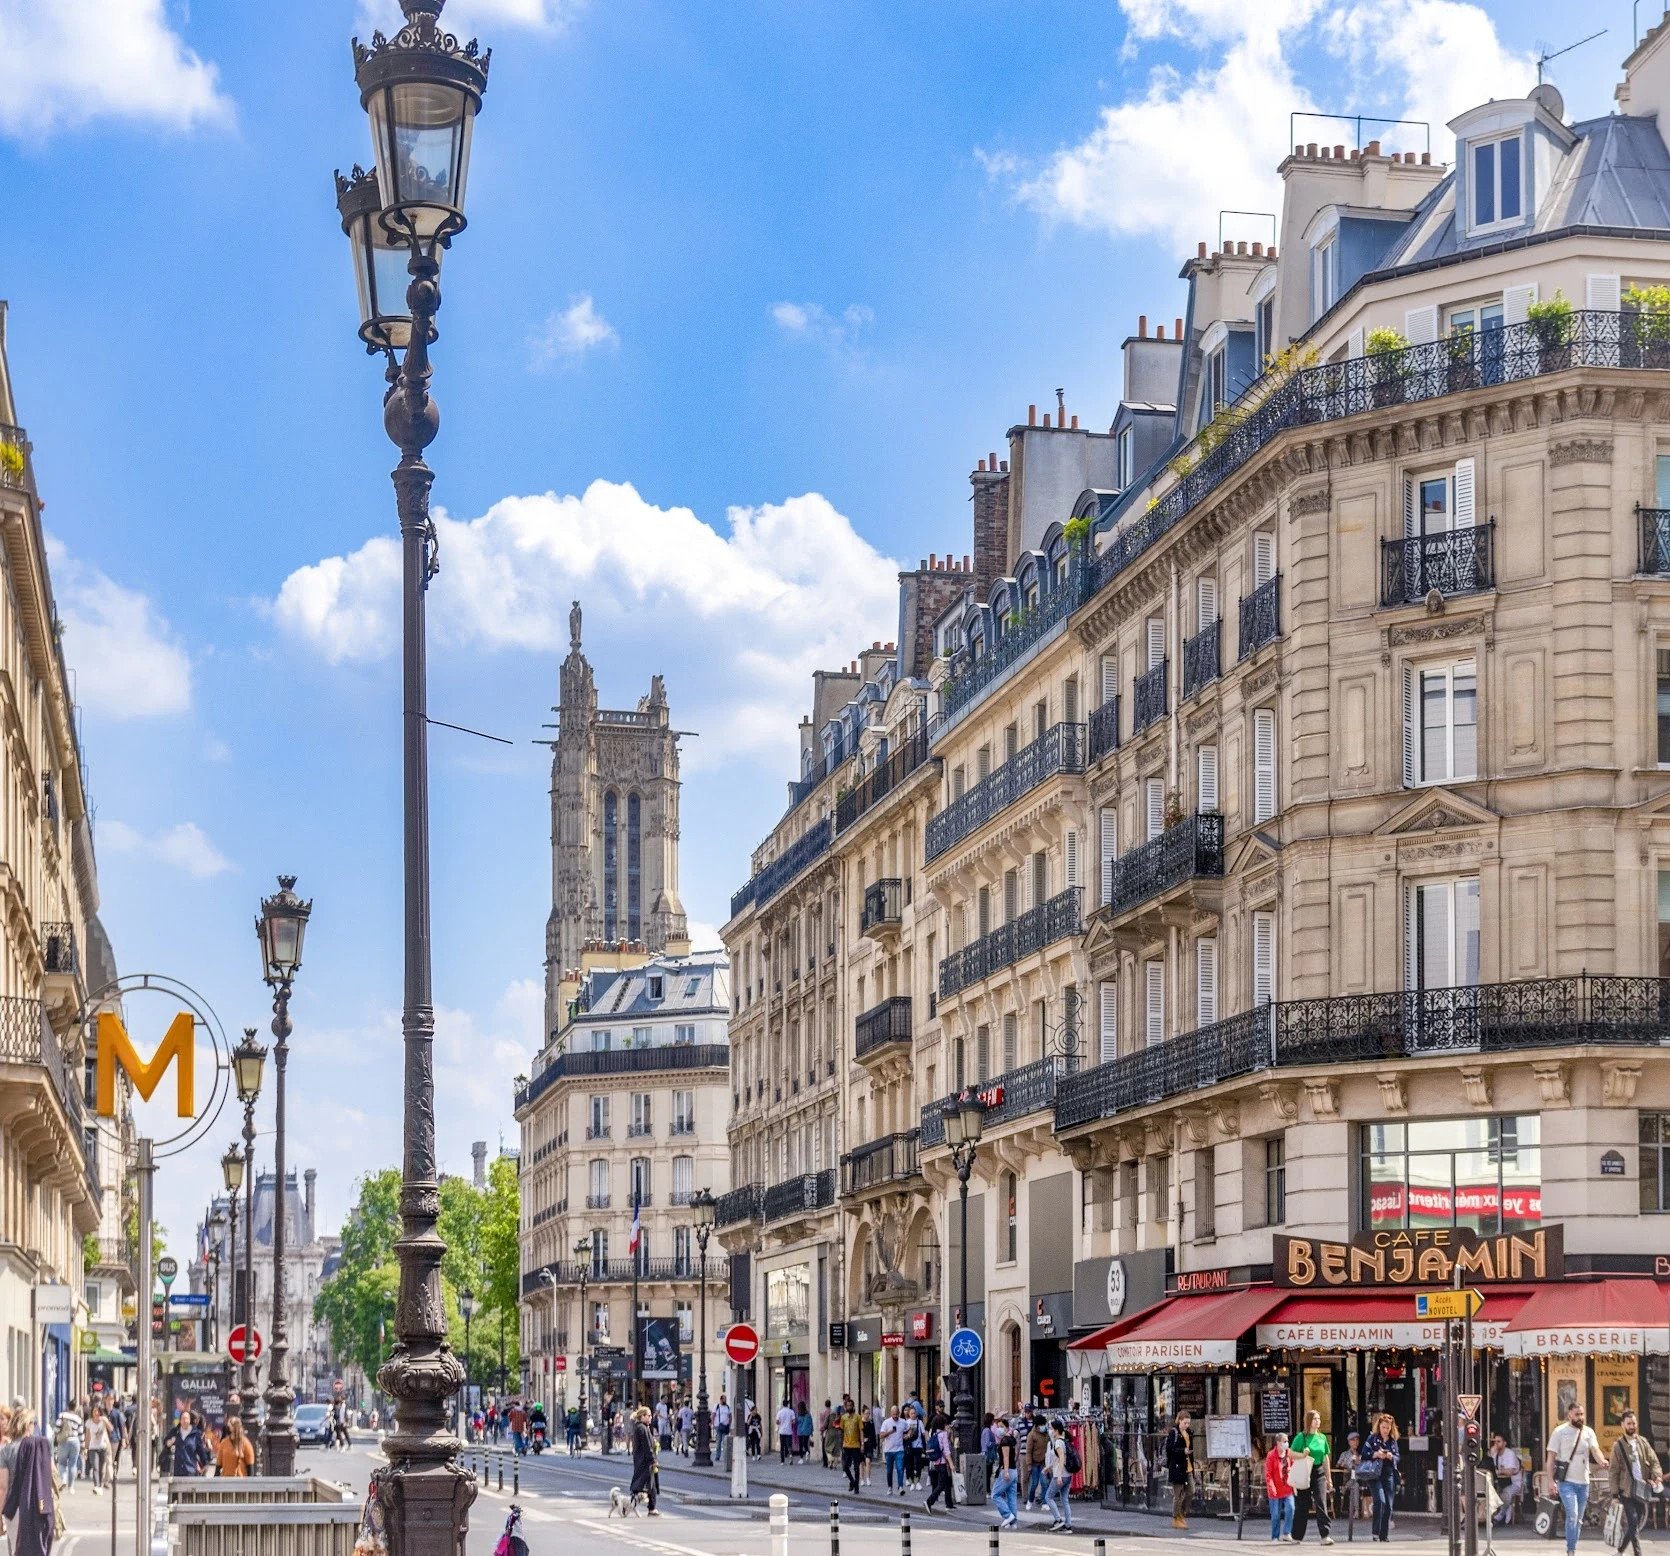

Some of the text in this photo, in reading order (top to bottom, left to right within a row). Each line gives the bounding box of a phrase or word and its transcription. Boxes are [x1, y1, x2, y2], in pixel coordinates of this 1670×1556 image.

[97, 1012, 194, 1117] M
[1374, 1230, 1451, 1247] CAFE
[1288, 1230, 1547, 1286] BENJAMIN
[160, 1262, 175, 1273] BUS
[1110, 1269, 1121, 1293] 53
[1177, 1270, 1229, 1292] RESTAURANT
[1434, 1295, 1452, 1304] Accès
[37, 1304, 70, 1313] promod
[1428, 1305, 1458, 1316] NOVOTEL
[1277, 1325, 1314, 1340] CAFÉ
[1320, 1328, 1394, 1340] BENJAMIN
[1536, 1332, 1638, 1347] BRASSERIE
[1145, 1344, 1203, 1357] PARISIEN
[181, 1379, 217, 1390] GALLIA
